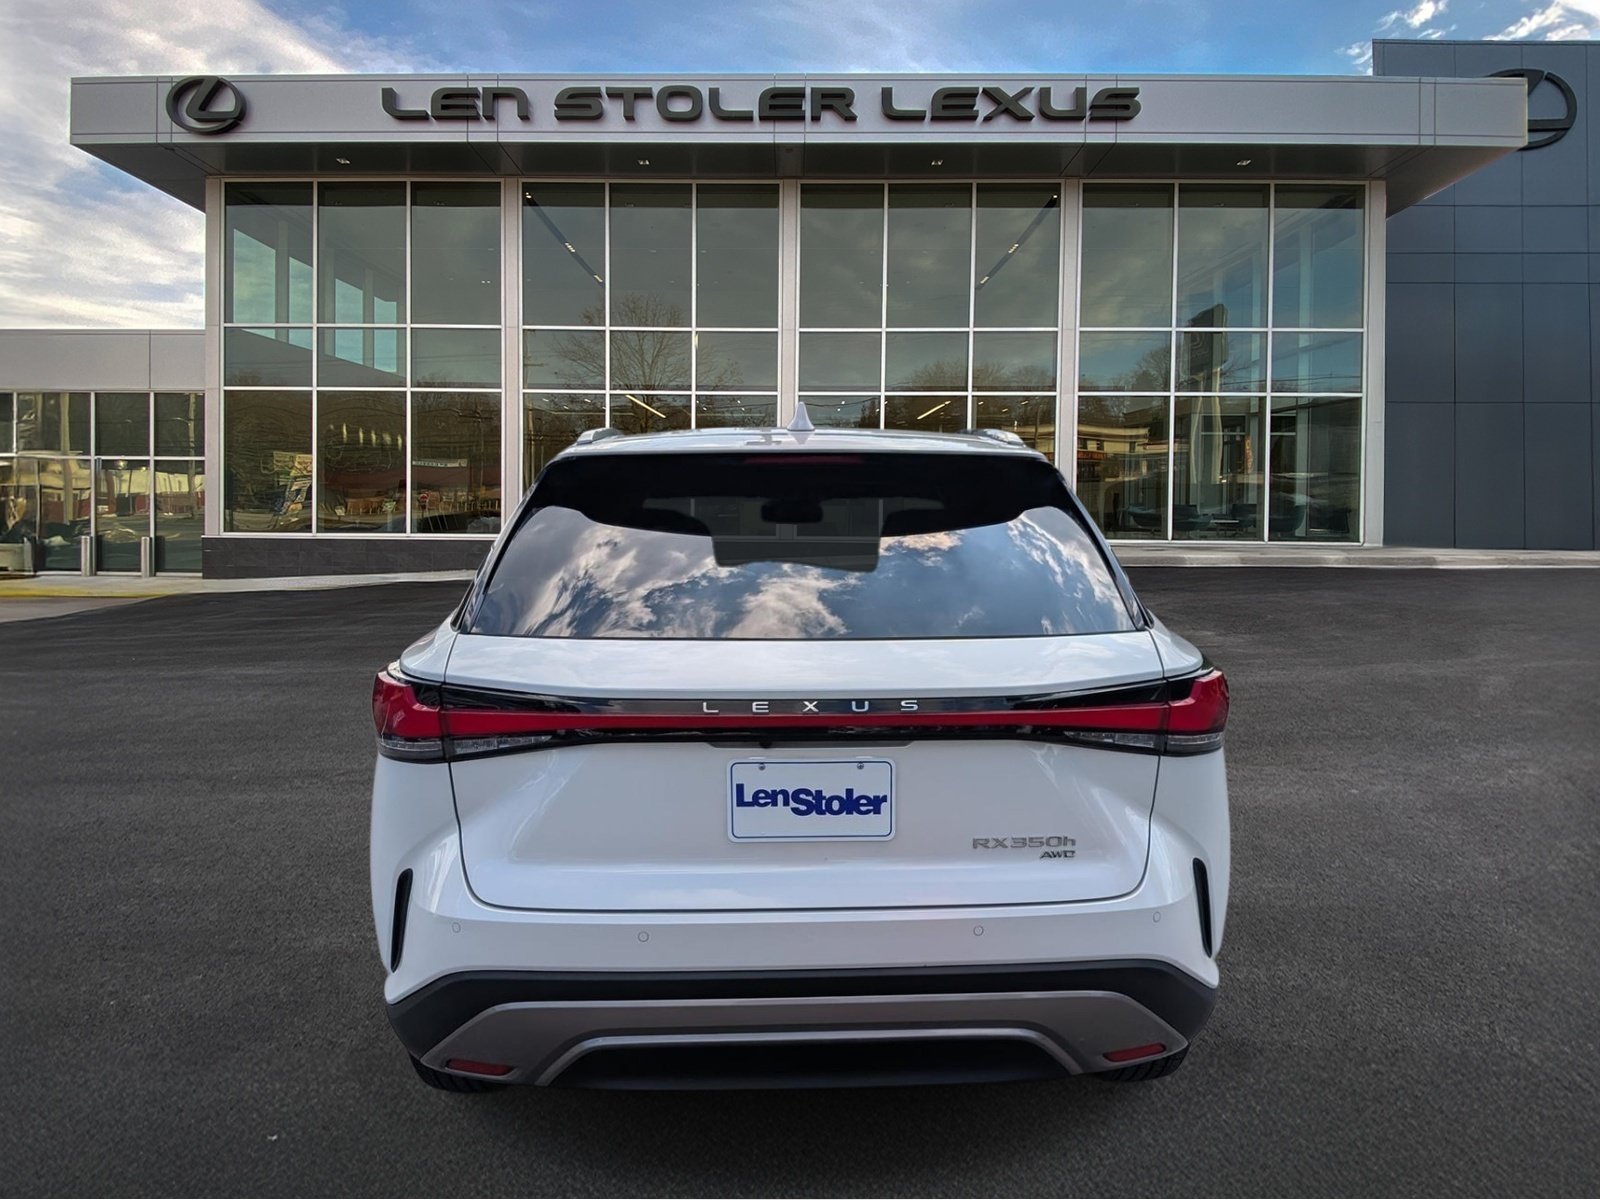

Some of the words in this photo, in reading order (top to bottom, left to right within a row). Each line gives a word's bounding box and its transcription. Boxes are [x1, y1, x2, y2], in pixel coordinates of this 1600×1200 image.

[554, 85, 857, 122] STOLER
[881, 86, 1142, 122] LEXUS
[702, 699, 919, 714] LEXUS
